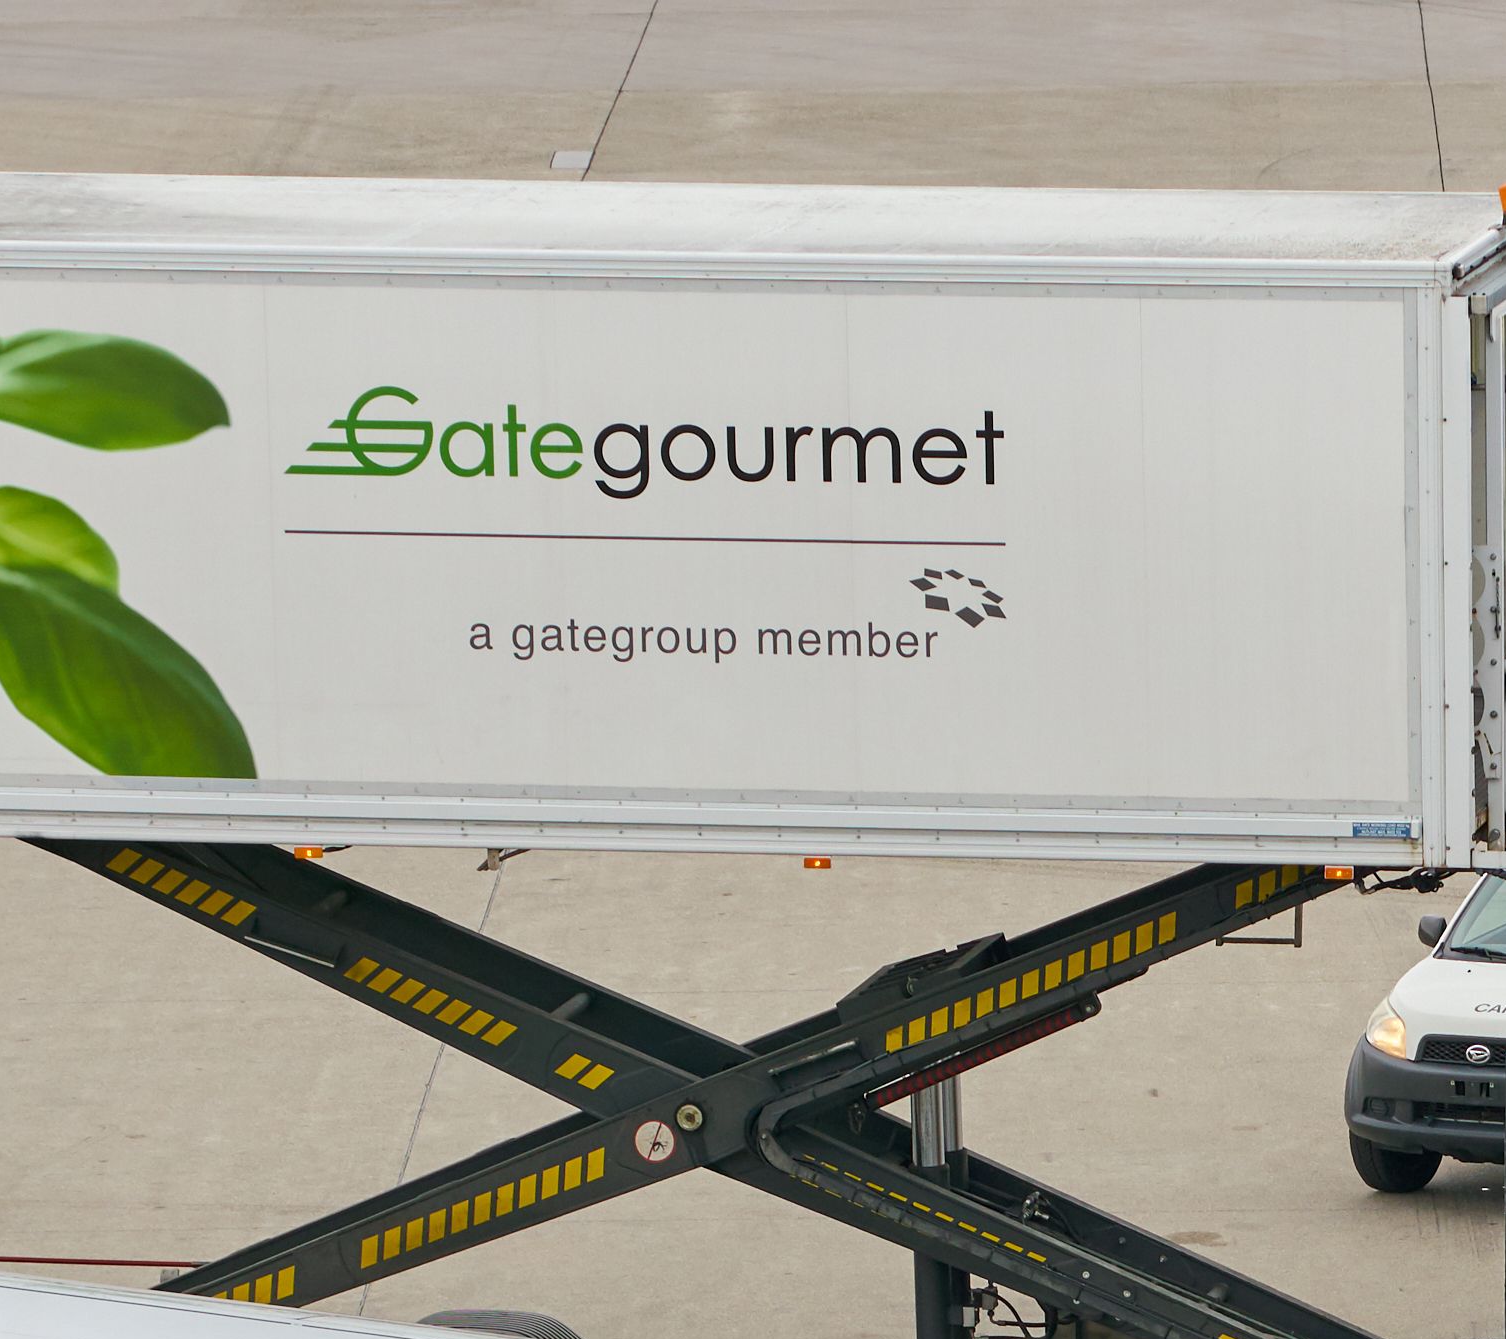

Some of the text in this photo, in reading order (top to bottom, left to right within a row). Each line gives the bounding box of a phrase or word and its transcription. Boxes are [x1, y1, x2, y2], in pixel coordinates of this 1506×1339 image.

[468, 618, 939, 664] a gategroup member
